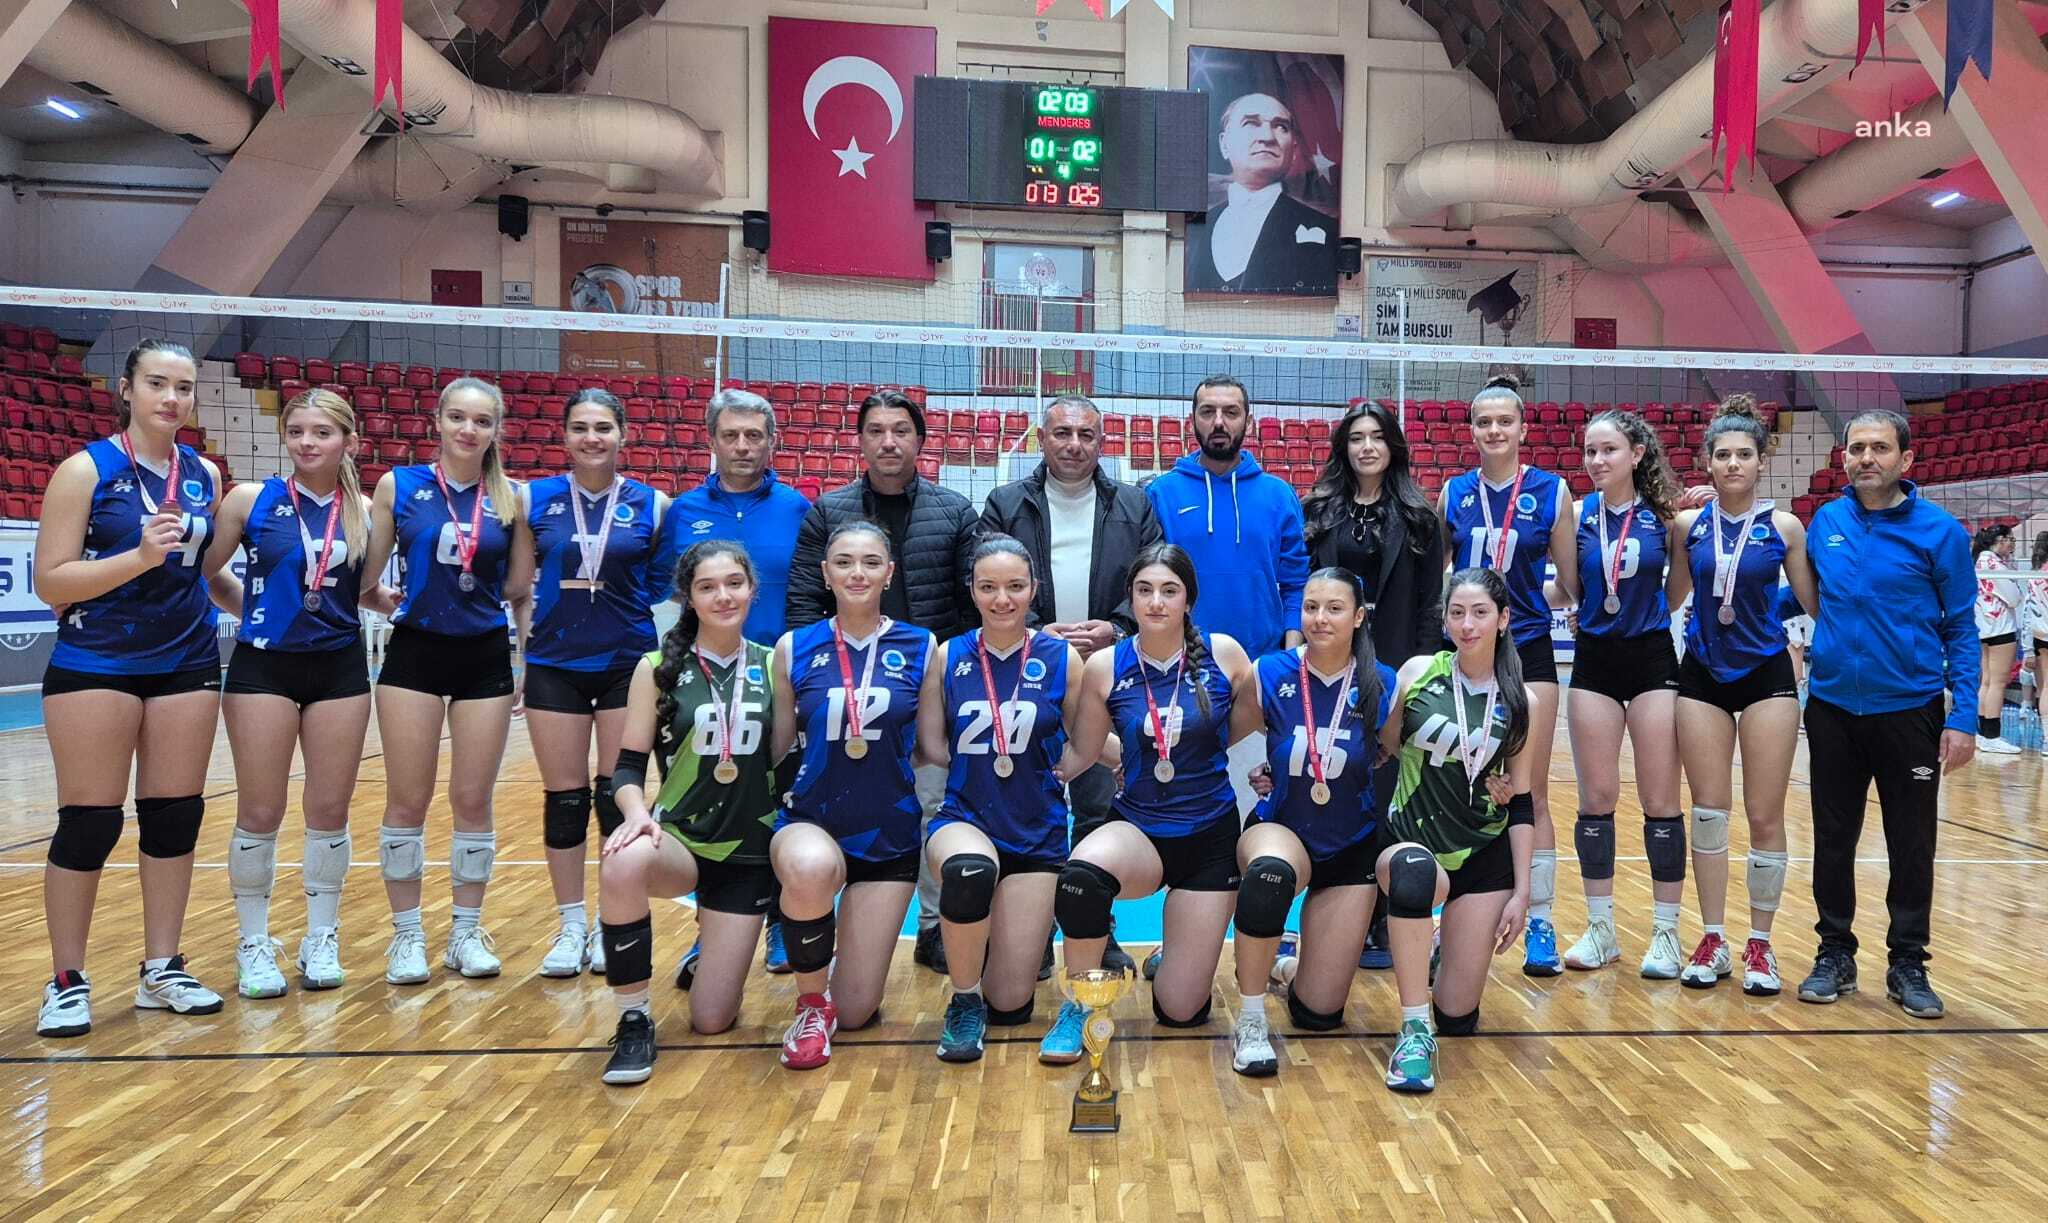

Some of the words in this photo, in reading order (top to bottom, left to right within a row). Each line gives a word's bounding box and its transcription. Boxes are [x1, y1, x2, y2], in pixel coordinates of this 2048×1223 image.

[1038, 115, 1091, 129] MENDERES
[1072, 139, 1096, 161] 02
[1026, 183, 1057, 203] 013
[1068, 185, 1100, 206] 025
[1410, 259, 1437, 268] SPORCU
[635, 274, 682, 298] SPOR
[1436, 288, 1467, 300] SPORCU
[1376, 301, 1409, 321] ŞİMİ
[1376, 322, 1399, 337] TAM
[1404, 323, 1453, 339] BURSLU!
[141, 512, 208, 567] 4
[437, 521, 474, 566] 6
[826, 687, 891, 741] 12
[957, 700, 1038, 755] 20
[1144, 706, 1184, 749] 9
[1289, 725, 1351, 780] 15
